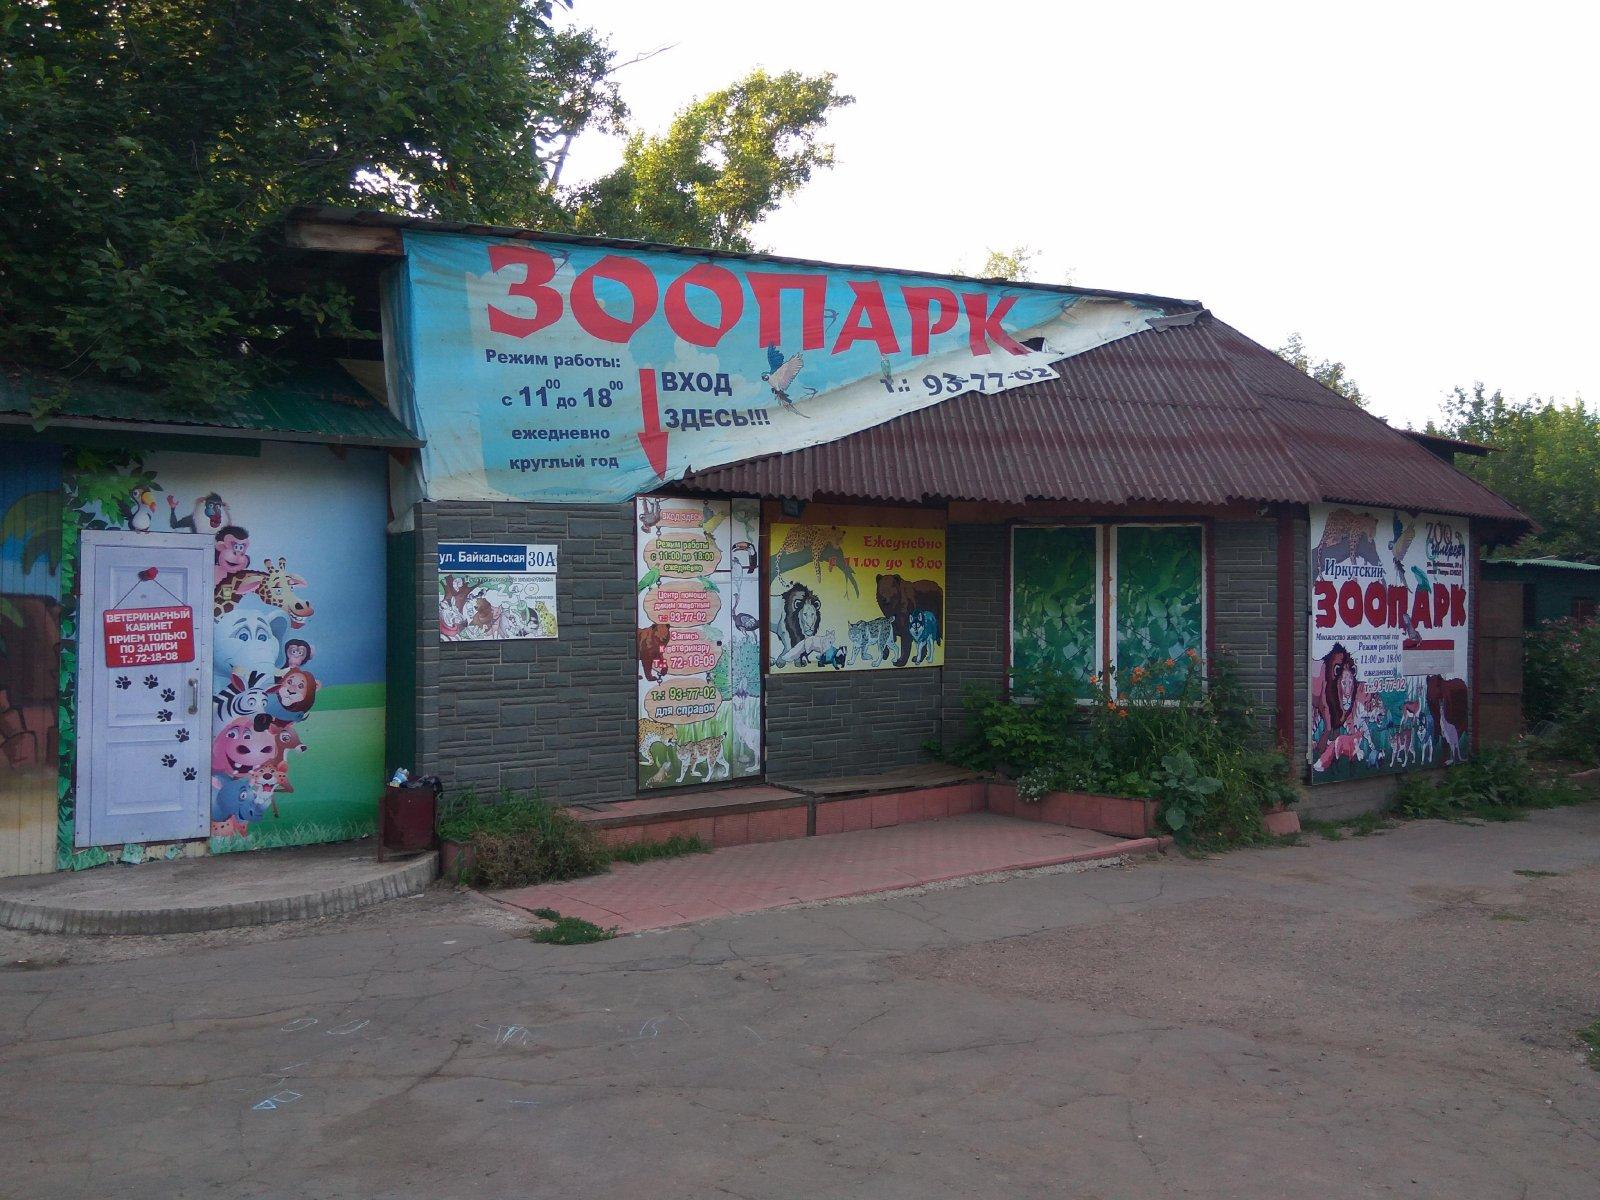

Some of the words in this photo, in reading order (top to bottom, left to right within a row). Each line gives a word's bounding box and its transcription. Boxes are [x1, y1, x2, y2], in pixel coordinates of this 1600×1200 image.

[486, 244, 1033, 357] ЗООПАРК
[485, 349, 548, 366] Режим
[554, 354, 621, 369] работы:
[661, 372, 733, 396] ВХОД
[922, 367, 1053, 396] 93-77-02
[664, 408, 771, 431] ЗДЕСЬ!!!
[511, 429, 610, 441] ежедневно
[509, 455, 585, 472] круглый
[591, 457, 619, 469] год
[656, 540, 681, 549] Режим
[682, 539, 710, 551] работы
[863, 535, 943, 550] Ежедневно
[439, 552, 456, 564] ул.
[458, 551, 525, 563] Байкальская
[528, 551, 556, 567] 30А
[1324, 558, 1385, 580] Иркутский
[1314, 580, 1467, 630] ЗООПАРК
[106, 608, 191, 623] ВЕТЕРИНАРНЫЙ
[670, 611, 707, 622] 93-77-02
[125, 621, 173, 632] КАБИНЕТ
[109, 634, 146, 644] ПРИЕМ
[147, 631, 188, 642] ТОЛЬКО
[671, 631, 700, 640] Запись
[120, 644, 135, 653] ПО
[137, 642, 178, 653] ЗАПИСИ
[1358, 642, 1377, 651] Режим
[135, 652, 179, 663] 72-18-08
[670, 654, 716, 669] 72-18-08
[668, 686, 717, 700] 93-77-02
[655, 705, 674, 718] для
[675, 703, 715, 716] справок
